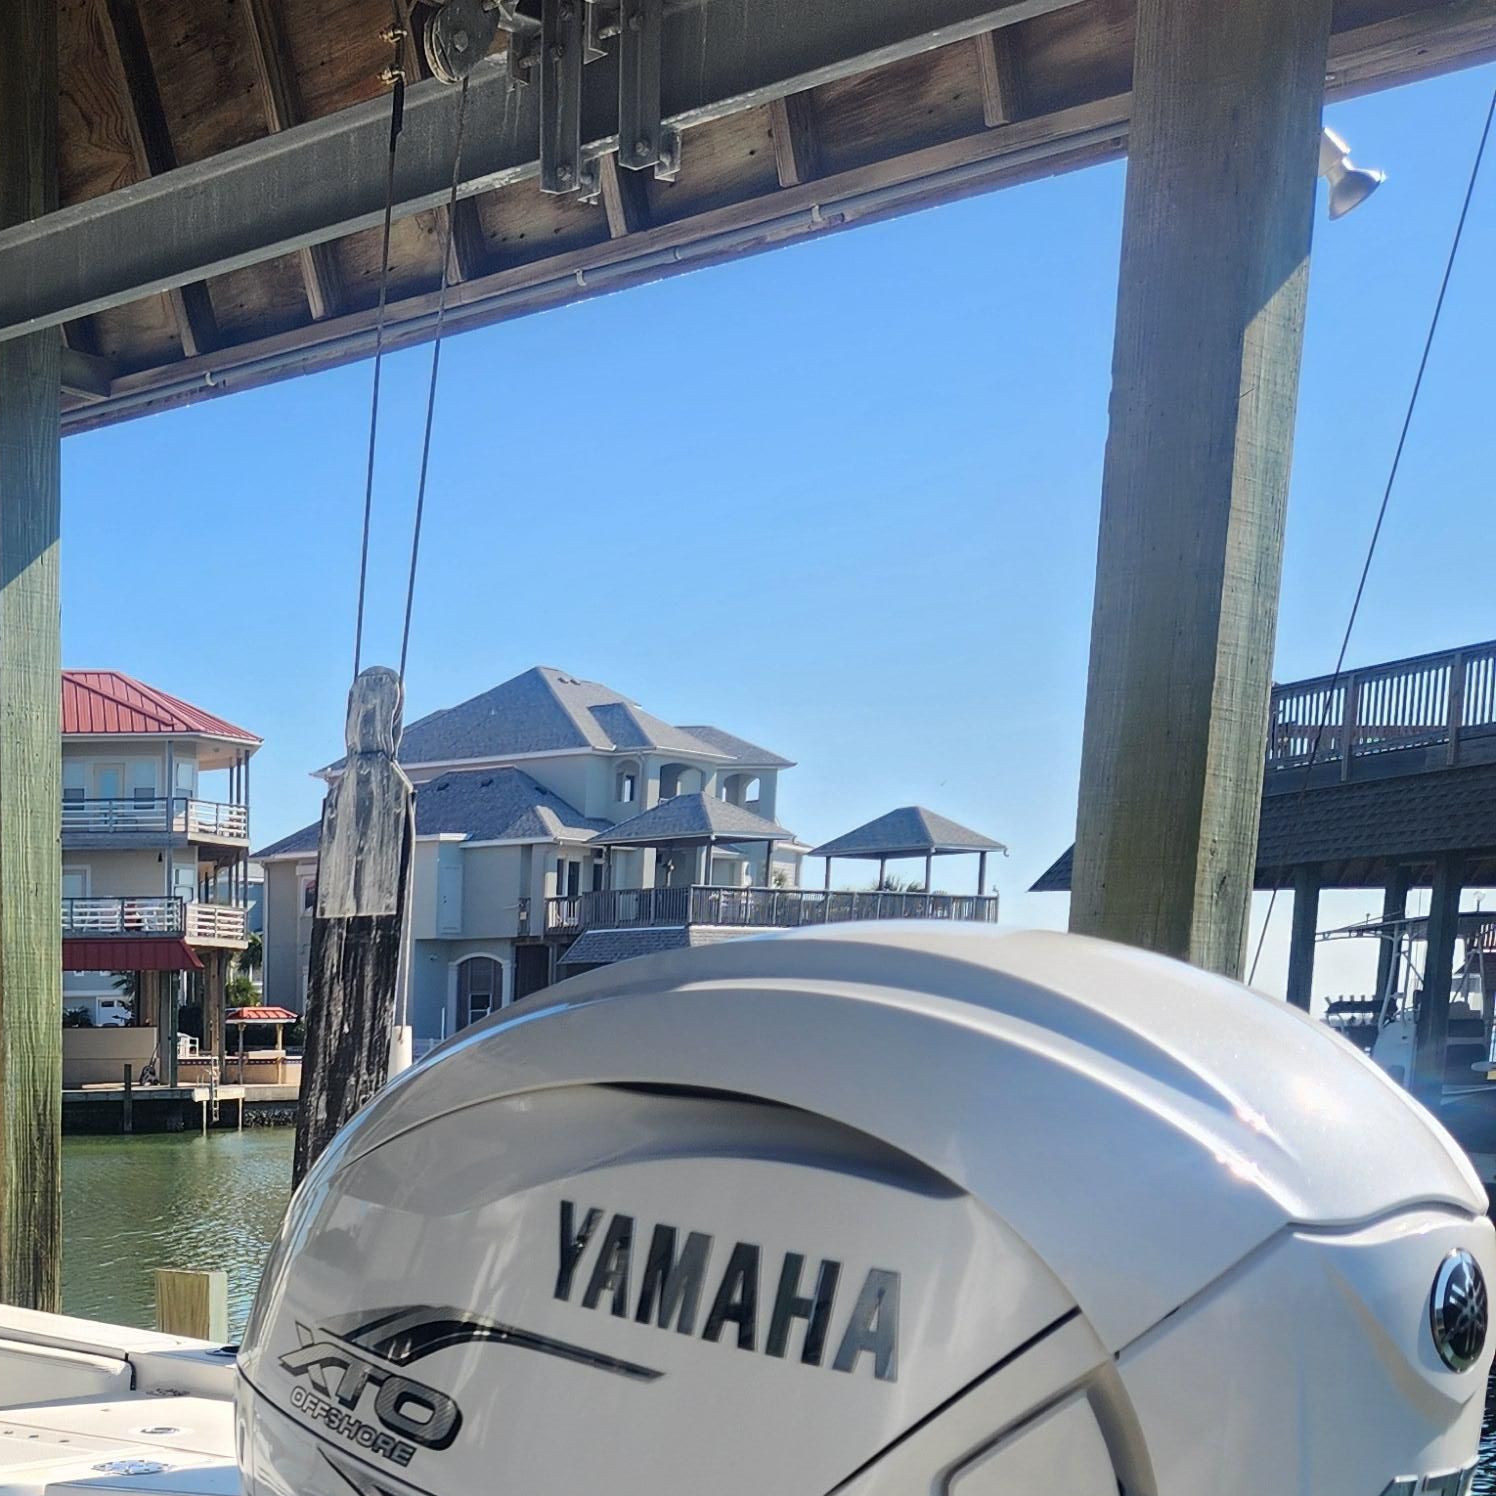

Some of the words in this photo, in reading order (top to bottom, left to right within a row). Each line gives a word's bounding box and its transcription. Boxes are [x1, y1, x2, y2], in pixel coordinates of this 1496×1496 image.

[554, 1199, 901, 1384] YAMAHA
[278, 1320, 463, 1451] XTO
[291, 1385, 417, 1467] OFFSHORE
